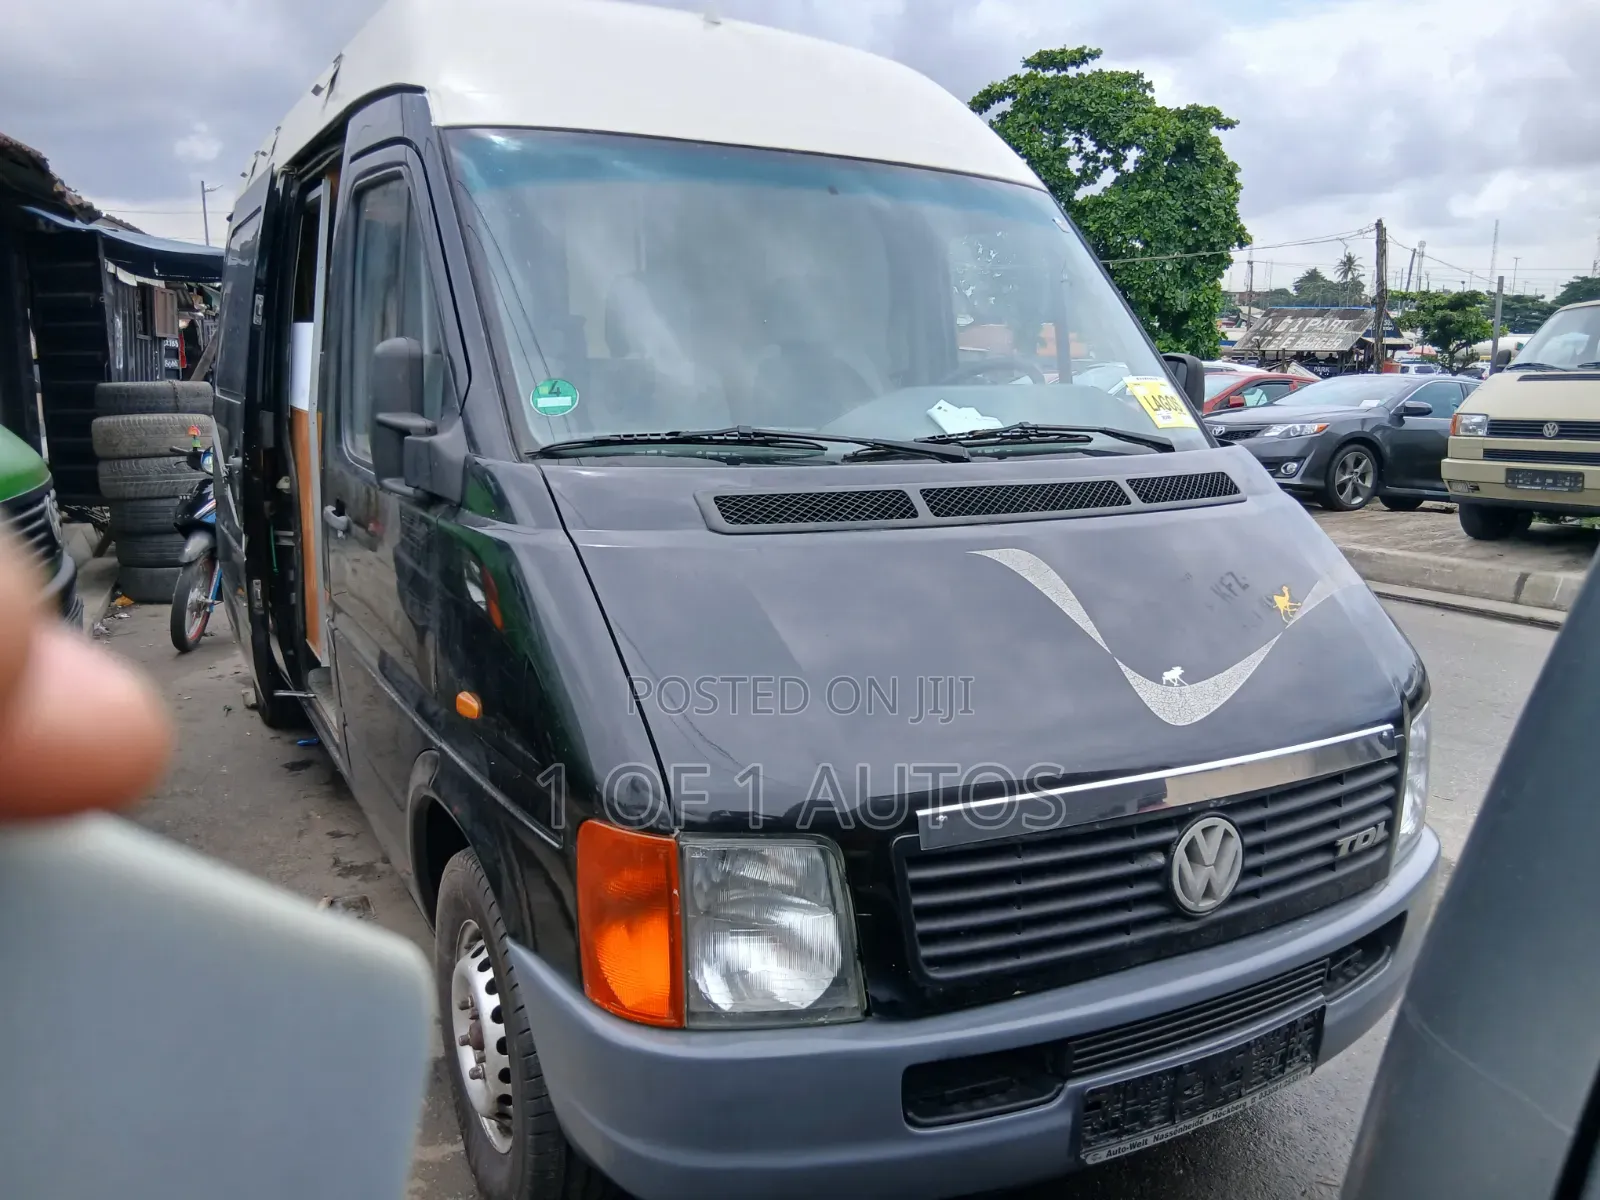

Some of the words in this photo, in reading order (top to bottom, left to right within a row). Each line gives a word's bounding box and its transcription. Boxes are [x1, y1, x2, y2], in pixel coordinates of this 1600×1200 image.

[1313, 366, 1331, 374] PARK
[548, 380, 562, 397] 4
[1143, 394, 1184, 413] LAGOS
[1105, 1138, 1149, 1159] Auto-Welt
[1152, 1117, 1205, 1143] Nassenheide
